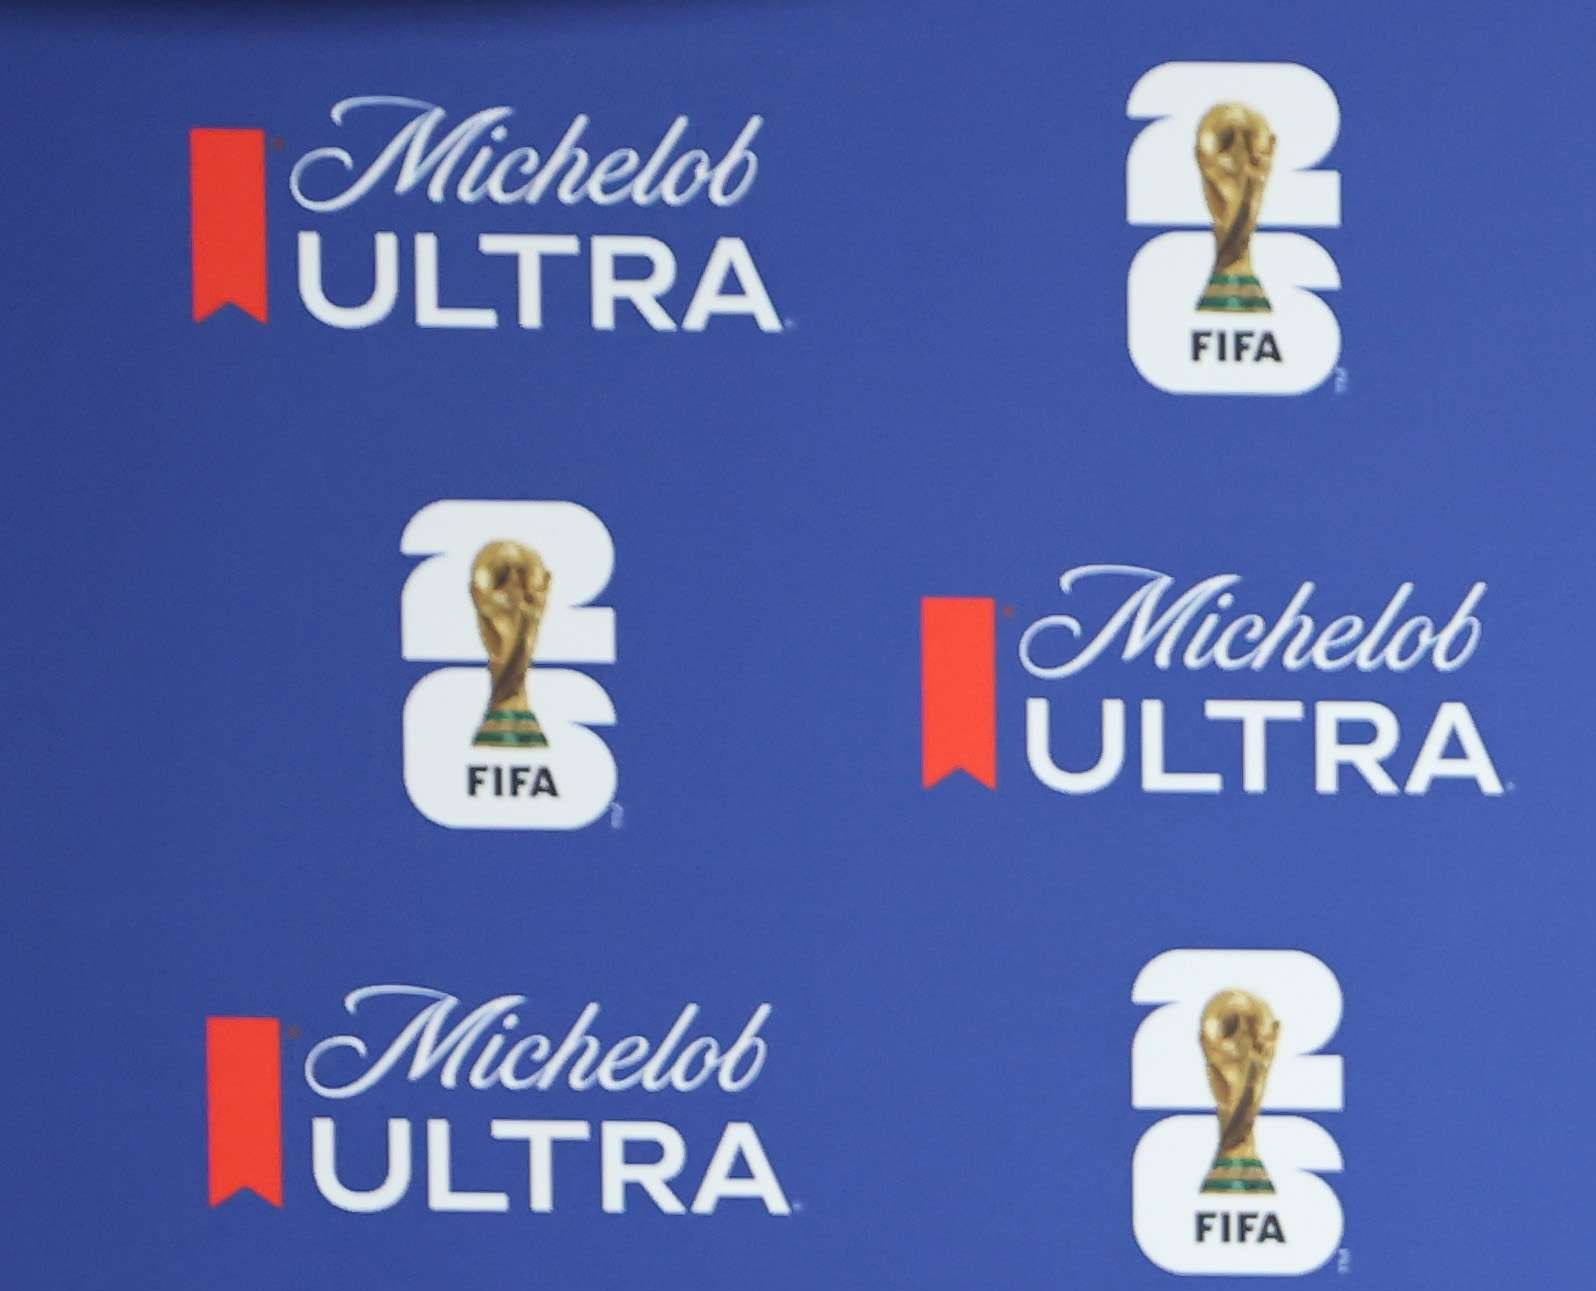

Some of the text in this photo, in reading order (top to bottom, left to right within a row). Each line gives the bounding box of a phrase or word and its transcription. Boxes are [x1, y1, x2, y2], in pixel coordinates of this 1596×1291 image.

[290, 96, 763, 212] Michelob
[298, 231, 784, 333] ULTRA
[1193, 332, 1281, 361] FIFA
[1019, 565, 1487, 679] Michelob
[469, 767, 558, 796] FIFA
[1026, 698, 1504, 797] ULTRA
[305, 985, 772, 1098] Michelob
[312, 1117, 792, 1216] ULTRA
[1197, 1214, 1284, 1242] FIFA
